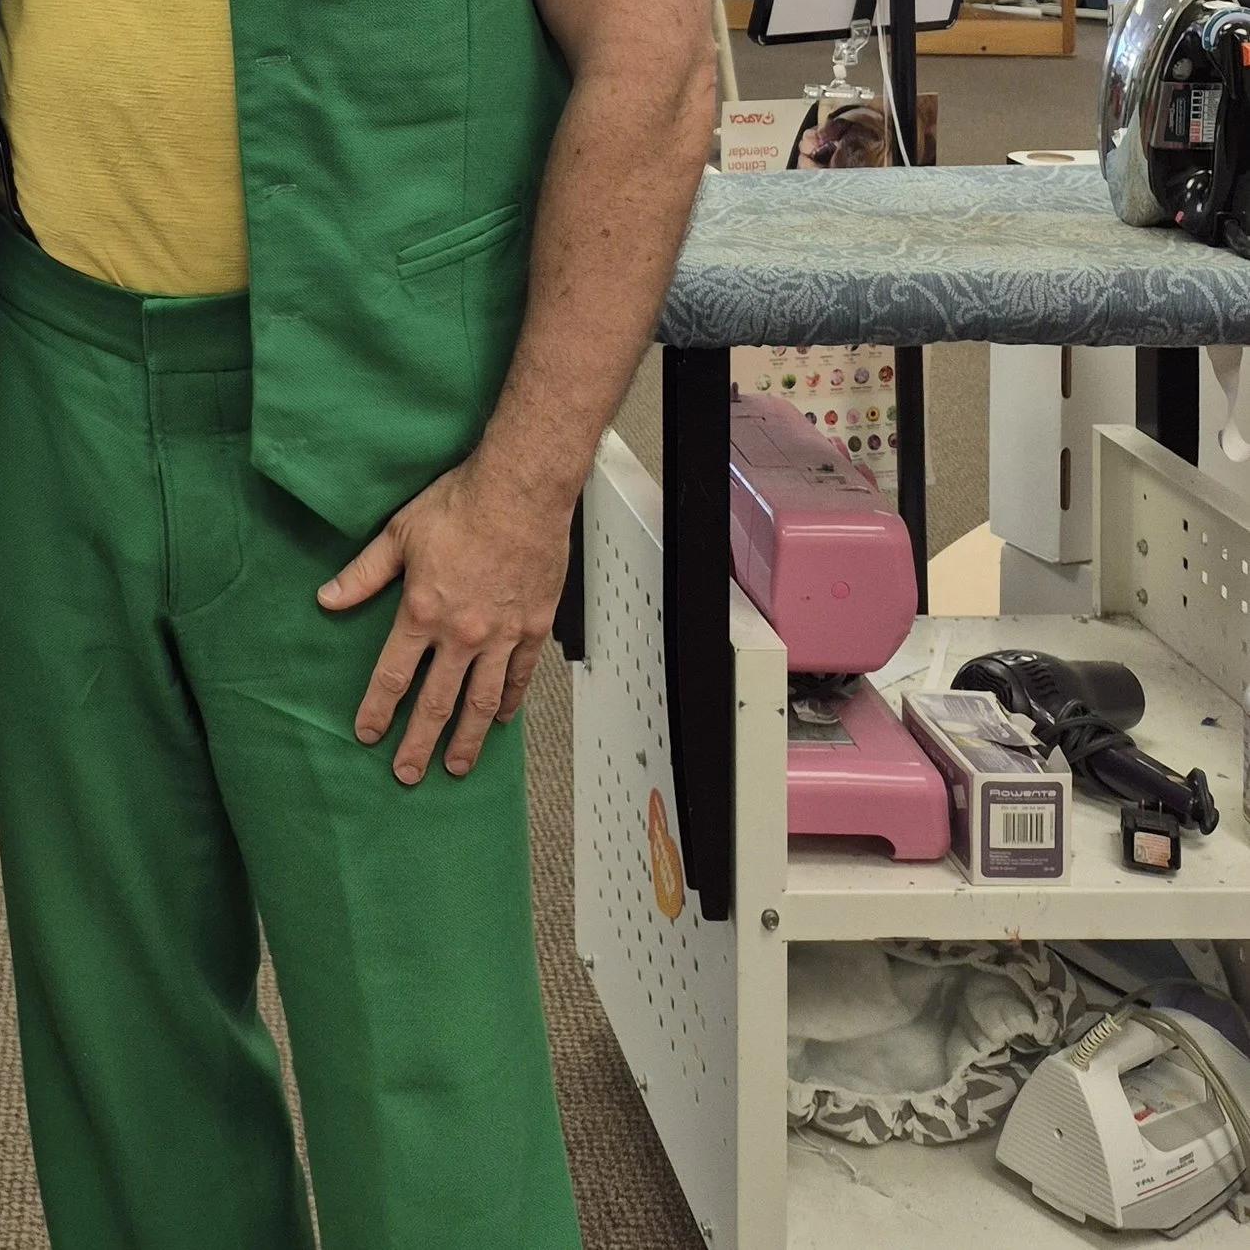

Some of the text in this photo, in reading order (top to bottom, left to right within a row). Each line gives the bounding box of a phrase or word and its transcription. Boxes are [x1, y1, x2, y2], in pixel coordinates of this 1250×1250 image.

[729, 114, 764, 125] ASPCA
[728, 146, 779, 158] Calendar
[727, 161, 767, 171] Edition
